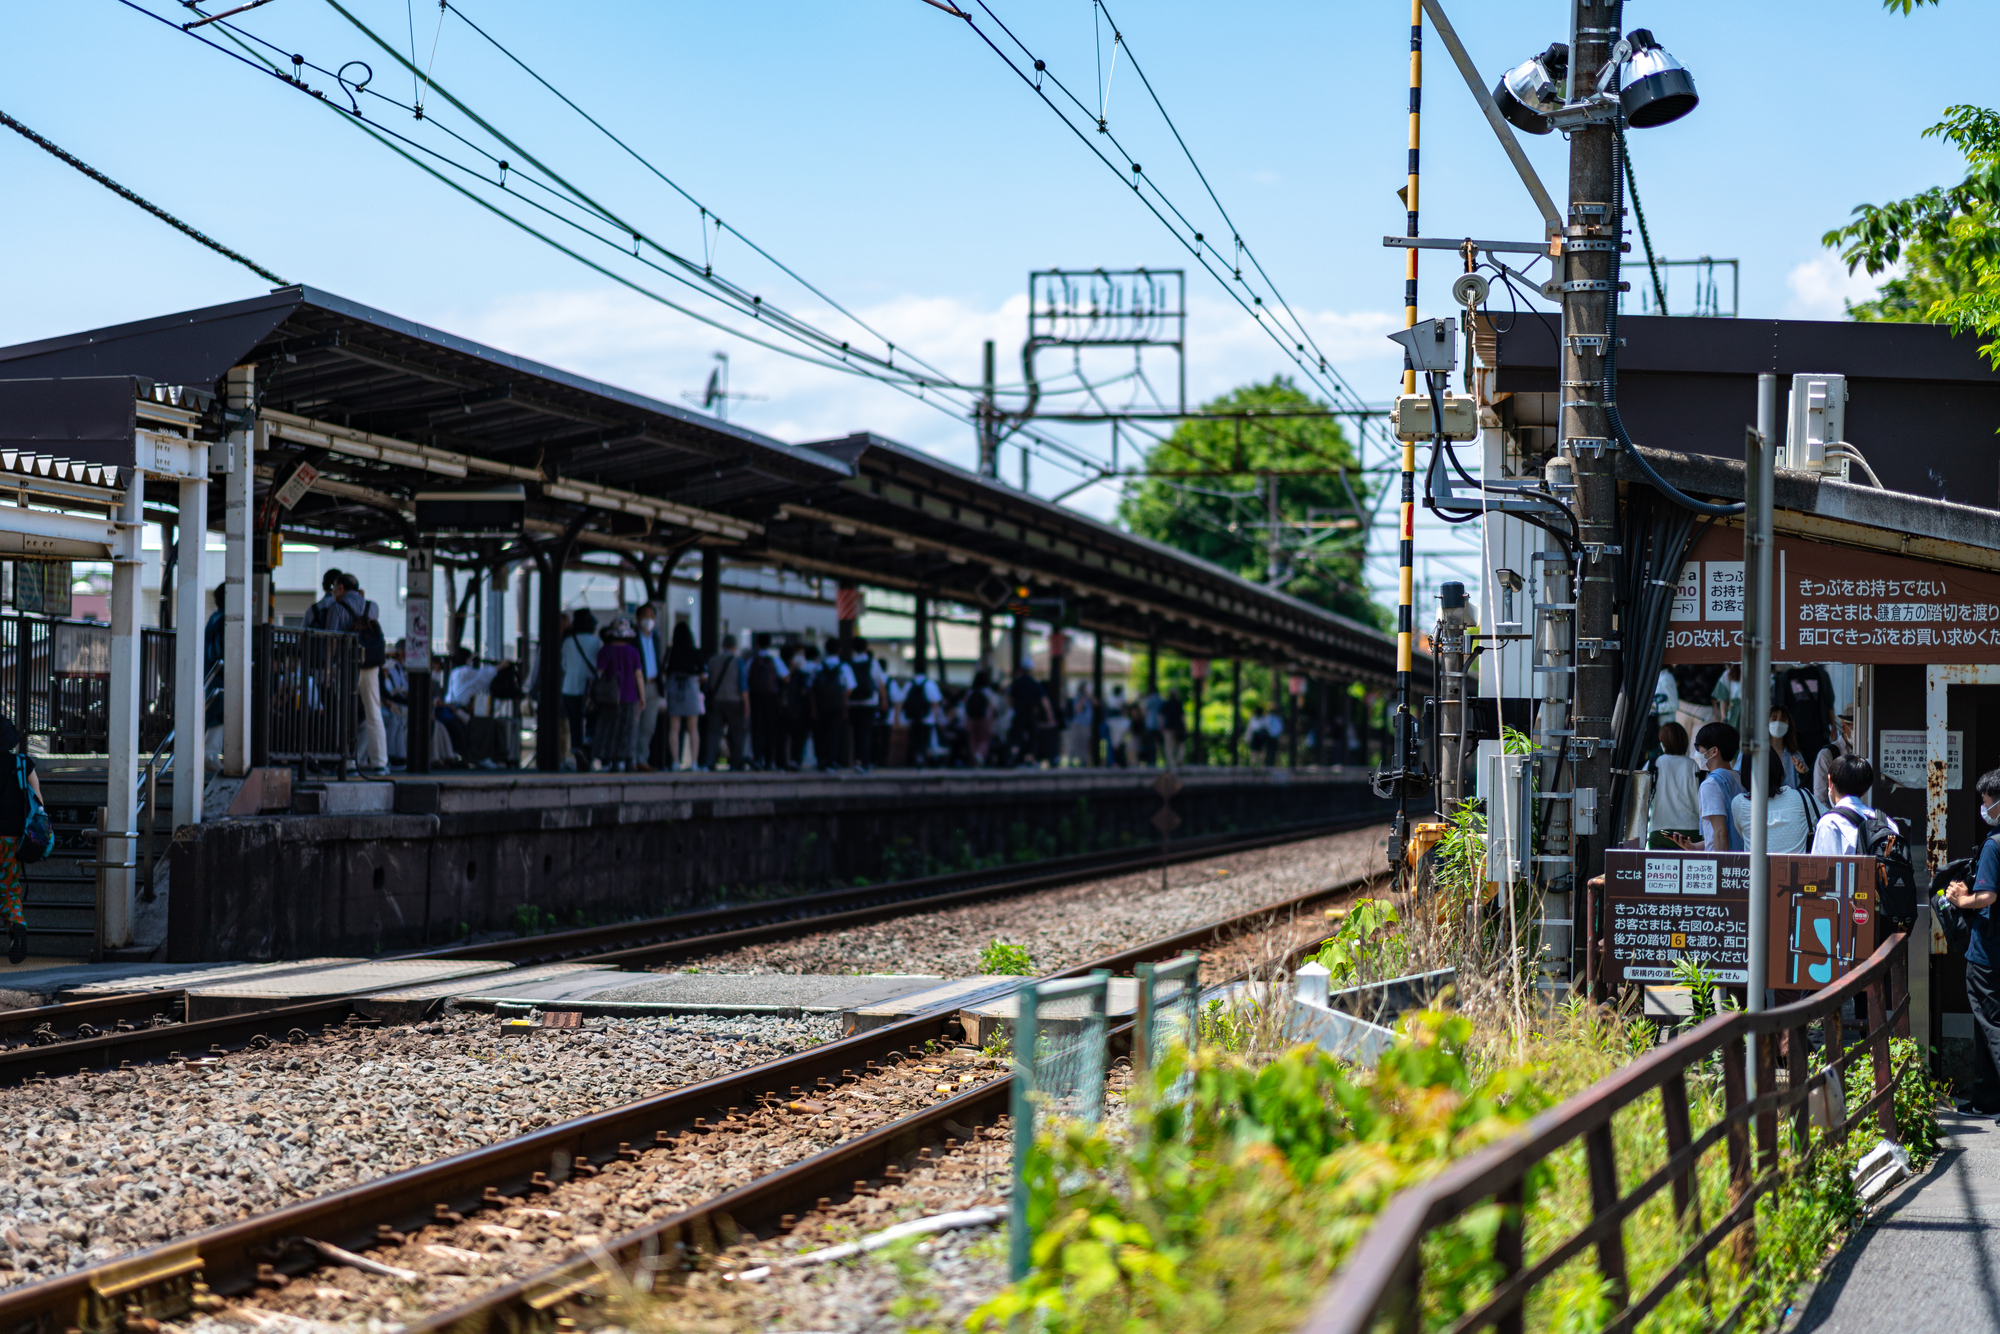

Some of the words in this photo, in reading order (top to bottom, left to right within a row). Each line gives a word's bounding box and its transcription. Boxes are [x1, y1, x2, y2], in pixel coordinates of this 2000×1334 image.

[1800, 579, 1947, 597] きっぷをお持ちでない
[1647, 863, 1678, 871] Suica
[1686, 865, 1713, 873] きっぷを
[1616, 870, 1642, 880] ここは
[1685, 873, 1714, 881] お持ちの
[1721, 867, 1750, 878] 専用の
[1685, 881, 1713, 889] お客さま
[1614, 904, 1730, 917] きっぷをお持ちでない
[1614, 918, 1746, 933] お客さまは、右図のように
